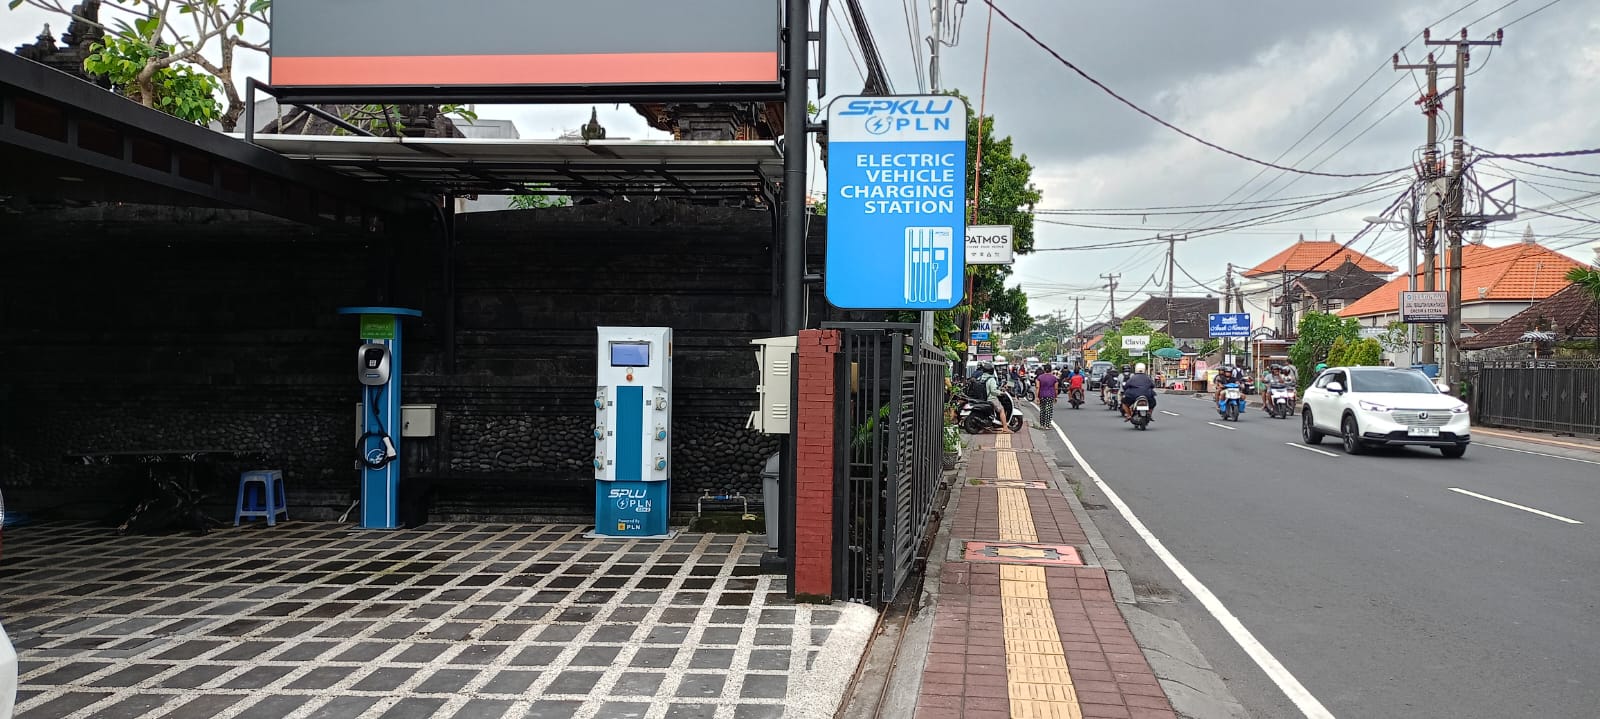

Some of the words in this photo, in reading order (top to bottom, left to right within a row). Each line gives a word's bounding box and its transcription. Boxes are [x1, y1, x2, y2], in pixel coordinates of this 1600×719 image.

[838, 100, 953, 115] SPKLU
[896, 118, 949, 131] PLN
[856, 153, 955, 167] ELECTRIC
[866, 169, 954, 183] VEHICLE
[840, 185, 954, 198] CHARGING
[864, 200, 953, 214] STATION
[965, 235, 1008, 244] PATMOS
[607, 489, 647, 498] SPLU
[629, 499, 652, 508] PLN
